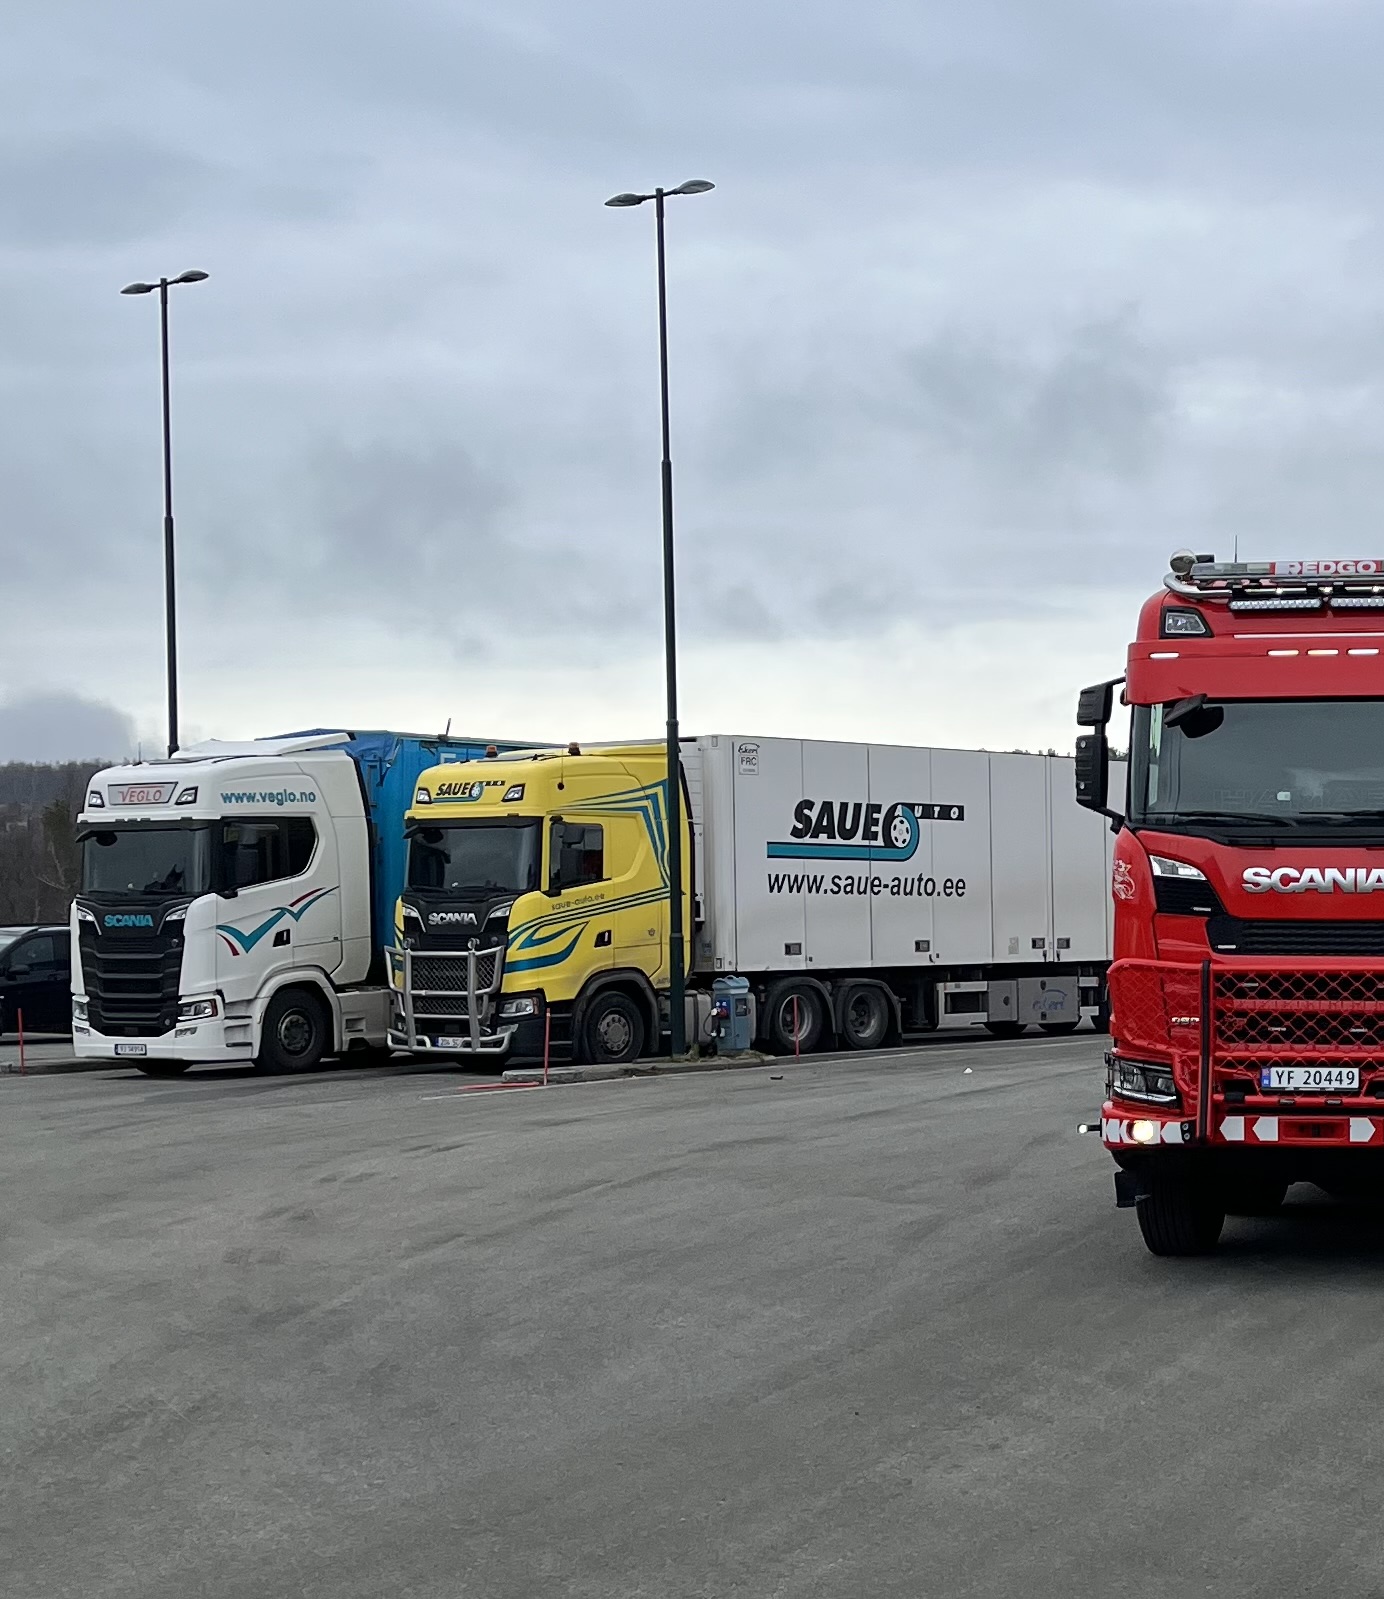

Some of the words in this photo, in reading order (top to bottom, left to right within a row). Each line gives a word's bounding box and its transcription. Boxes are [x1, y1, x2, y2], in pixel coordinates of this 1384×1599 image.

[1286, 560, 1377, 576] REDGO
[118, 786, 164, 803] VEGLO
[220, 788, 317, 807] www.veglo.no
[435, 782, 471, 797] SAUE
[789, 798, 883, 842] SAUE
[894, 804, 960, 820] AUTO
[767, 872, 967, 898] www.saue-auto.ee
[103, 914, 154, 927] SCANIA
[428, 912, 478, 926] SCANIA
[1275, 1069, 1295, 1085] YF
[1302, 1069, 1356, 1086] 20449
